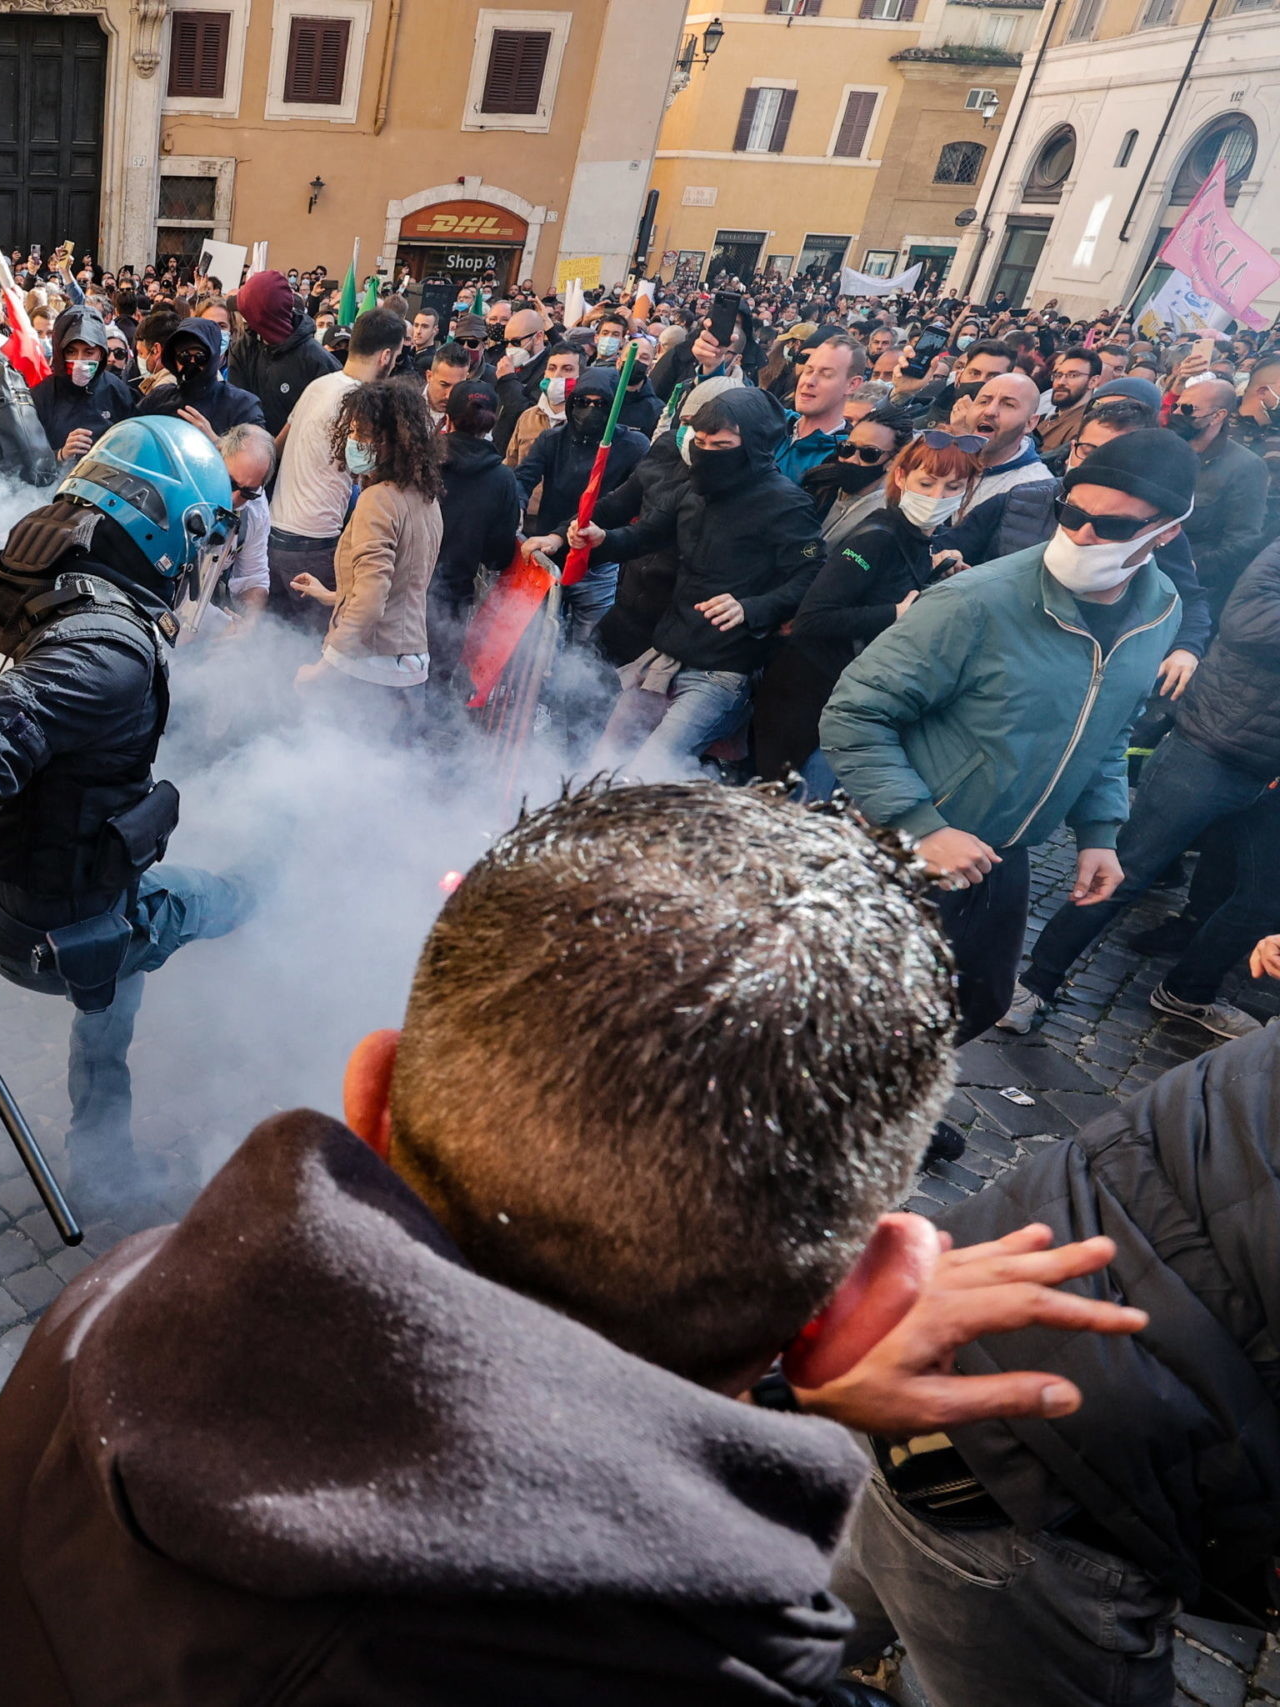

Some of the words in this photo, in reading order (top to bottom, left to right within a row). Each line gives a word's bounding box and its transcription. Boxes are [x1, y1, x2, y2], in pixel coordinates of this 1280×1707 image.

[429, 214, 500, 235] DHL
[446, 254, 483, 272] Shop
[485, 254, 496, 268] &
[841, 547, 871, 572] partesa
